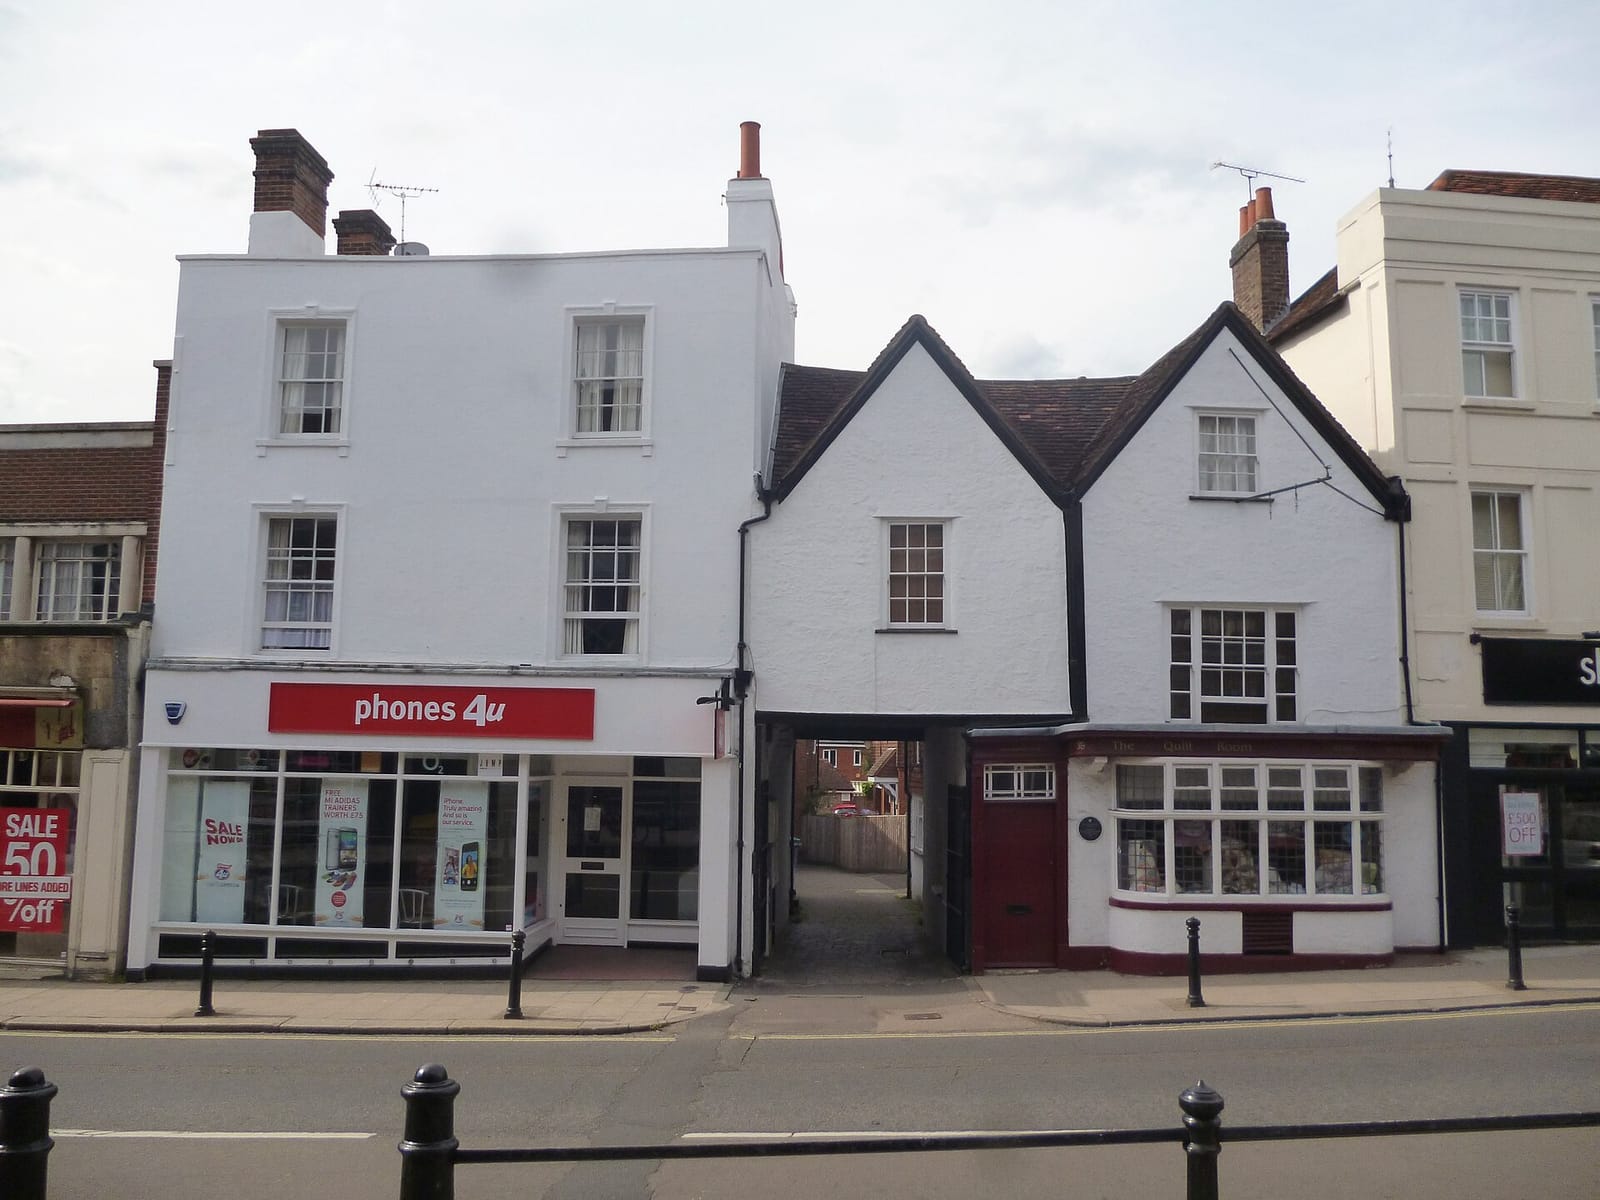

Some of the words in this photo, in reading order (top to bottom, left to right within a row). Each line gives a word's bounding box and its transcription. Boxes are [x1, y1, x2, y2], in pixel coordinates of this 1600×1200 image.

[355, 693, 456, 725] phones
[463, 694, 506, 727] 4u
[1113, 741, 1135, 751] The
[1163, 741, 1192, 752] Quill
[1216, 742, 1253, 752] Room
[5, 813, 59, 838] SALE
[205, 818, 242, 835] SALE
[1508, 812, 1537, 825] £500
[207, 835, 235, 845] NOW
[1509, 827, 1537, 843] OFF
[3, 841, 57, 875] 50
[15, 882, 39, 892] LINES
[41, 882, 69, 893] ADDED
